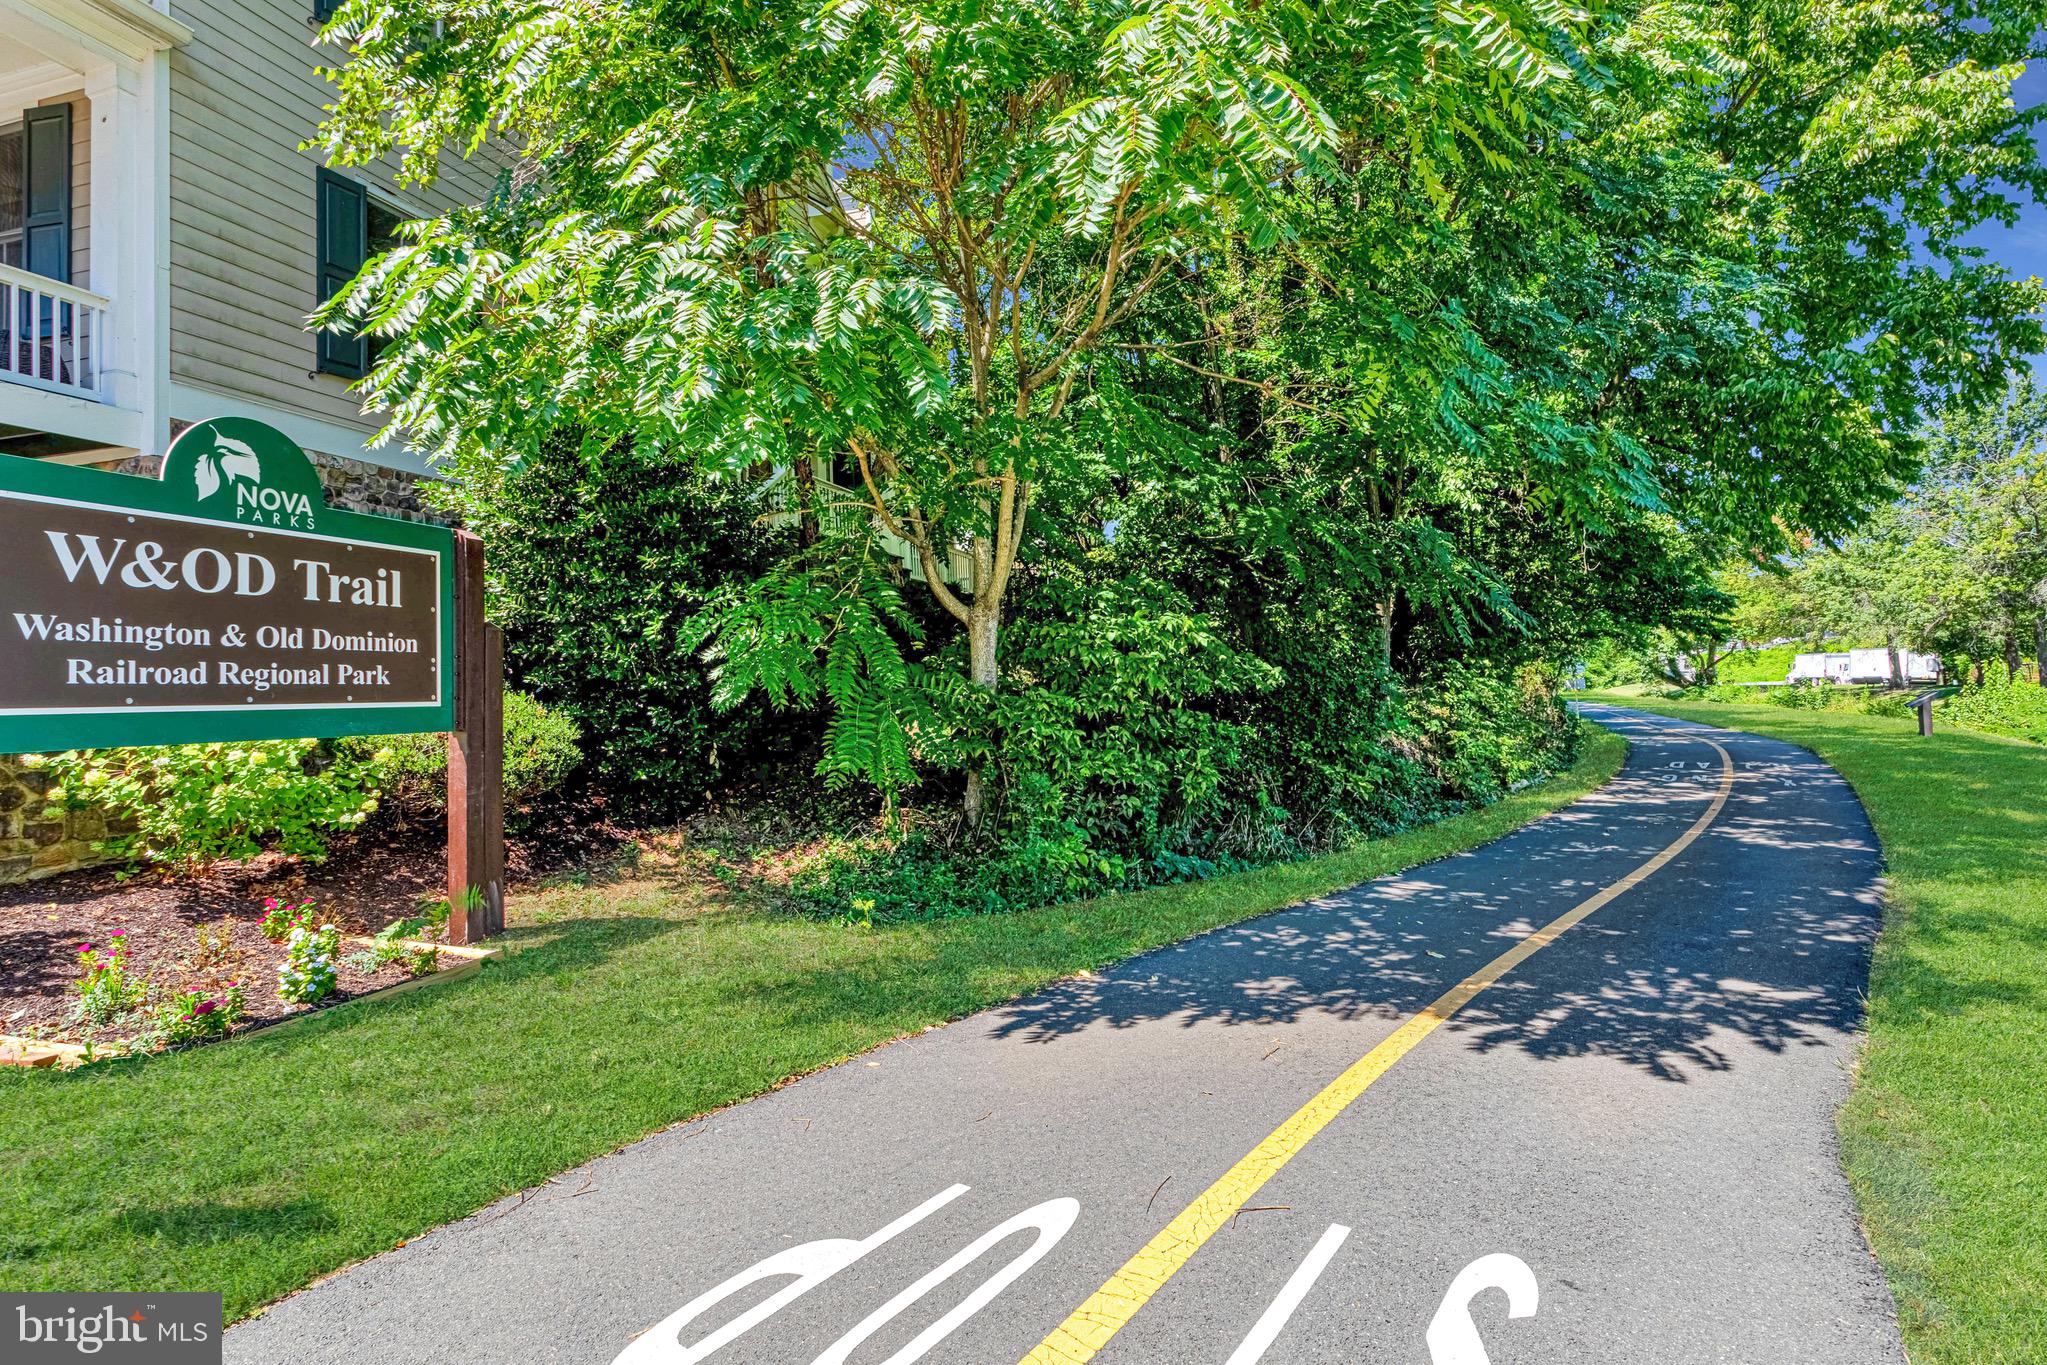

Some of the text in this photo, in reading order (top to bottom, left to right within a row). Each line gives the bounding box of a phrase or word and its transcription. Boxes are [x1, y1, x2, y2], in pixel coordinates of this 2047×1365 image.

[237, 483, 314, 517] NOVA
[236, 507, 315, 530] PARKS
[44, 530, 403, 608] W&OD Trail
[13, 612, 418, 653] Washington & Old Dominion
[66, 658, 391, 691] Railroad Regional Park
